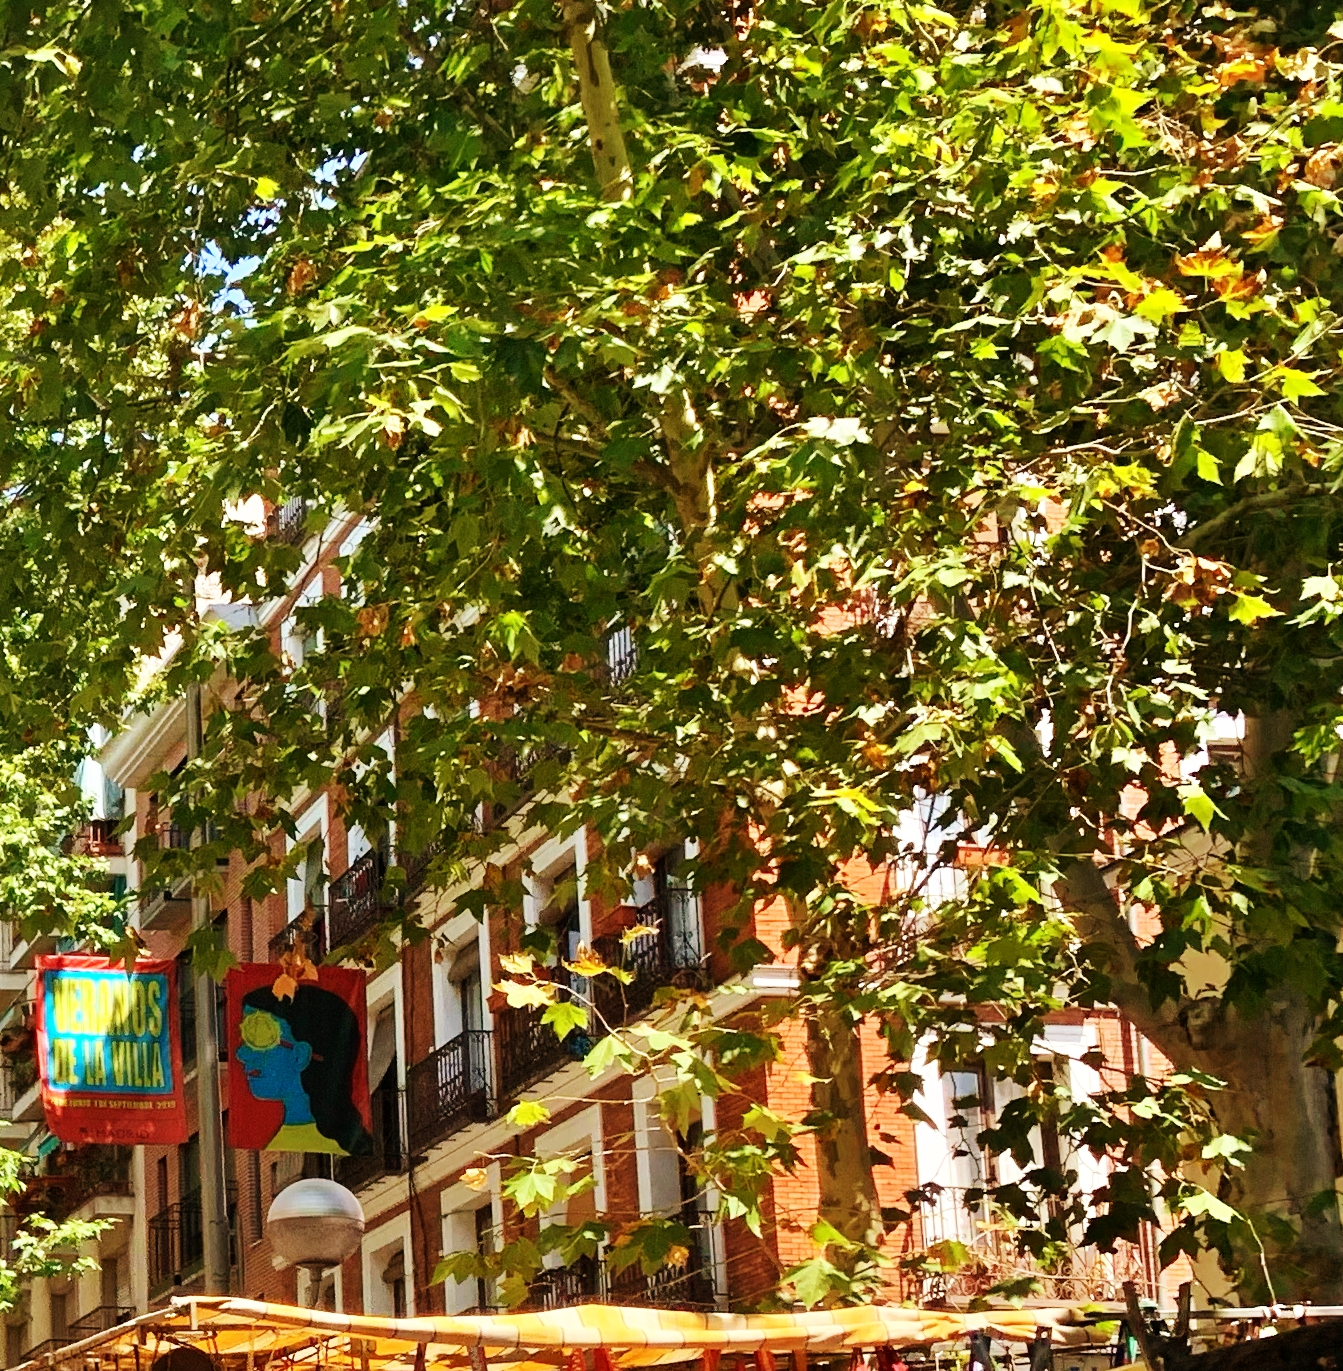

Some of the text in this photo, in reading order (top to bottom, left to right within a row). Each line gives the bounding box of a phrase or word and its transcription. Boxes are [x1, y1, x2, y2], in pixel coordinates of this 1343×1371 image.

[53, 979, 163, 1037] VERANOS
[54, 1038, 164, 1088] DE LA VILLA
